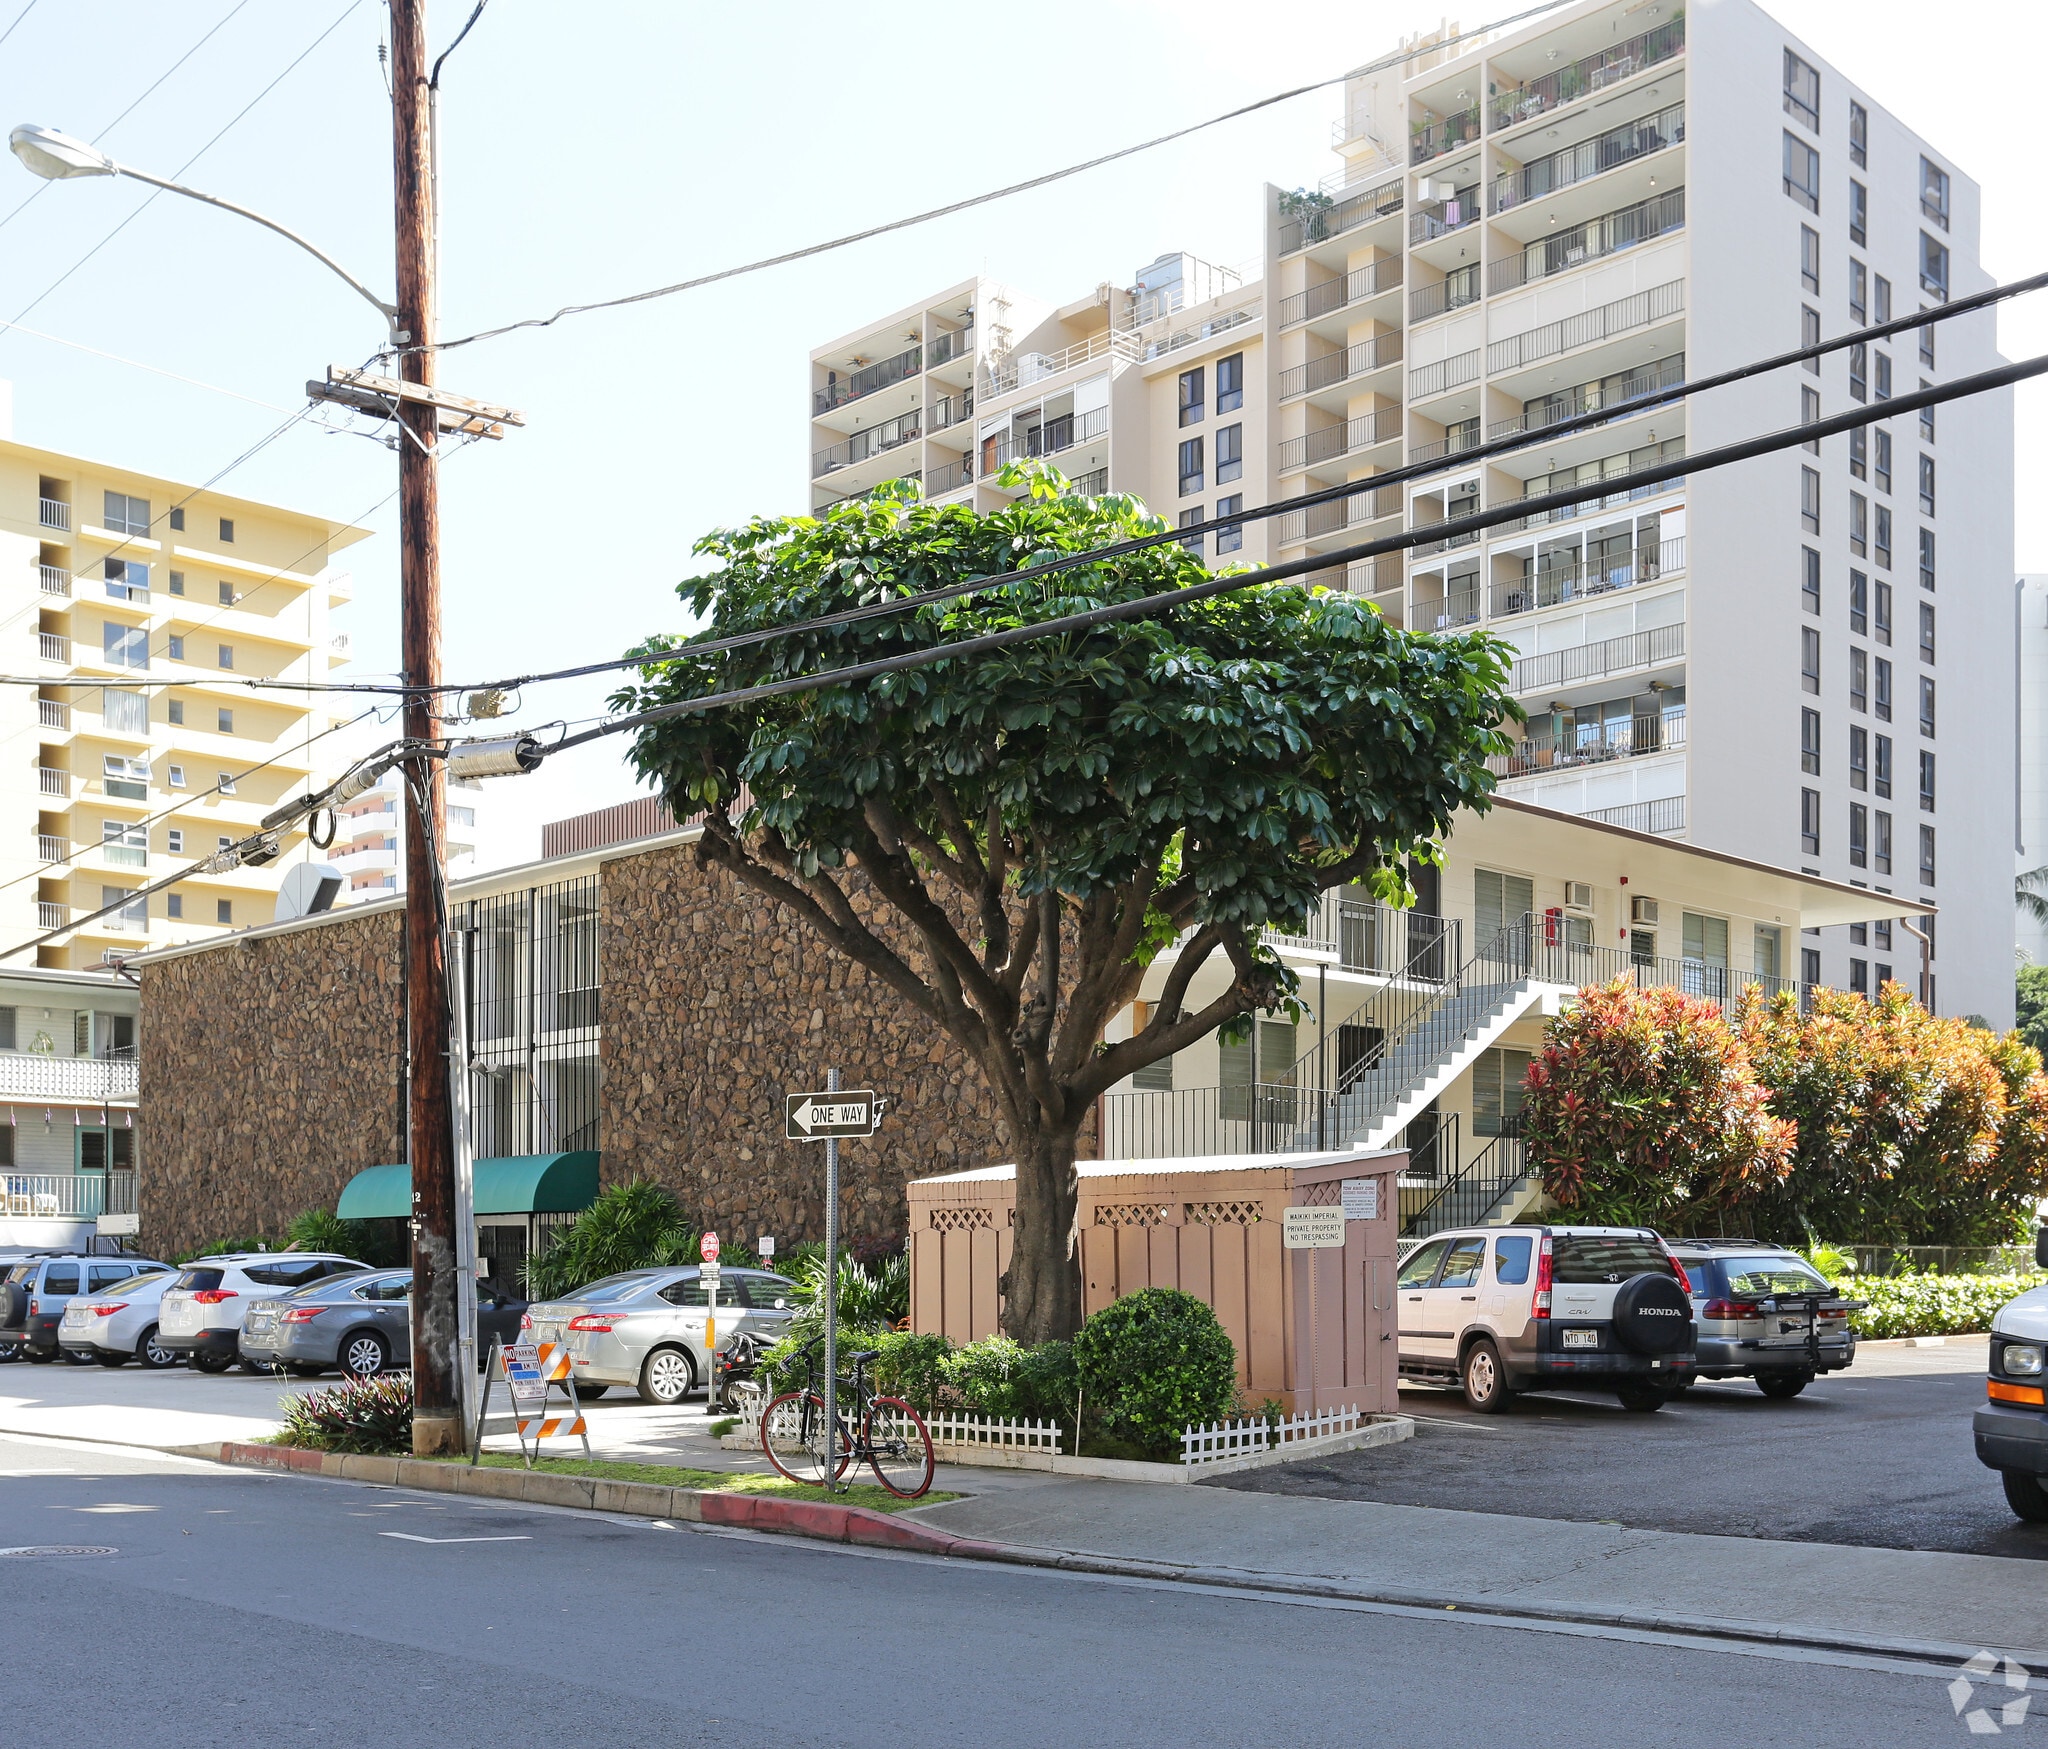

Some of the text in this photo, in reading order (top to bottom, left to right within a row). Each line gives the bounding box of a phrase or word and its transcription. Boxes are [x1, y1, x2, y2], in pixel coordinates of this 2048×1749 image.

[811, 1107, 834, 1124] ONE
[841, 1105, 863, 1122] WAY
[1313, 1212, 1339, 1220] IMPERIAL
[1638, 1307, 1682, 1317] HONDA
[1583, 1334, 1596, 1344] 140
[505, 1349, 515, 1359] NO
